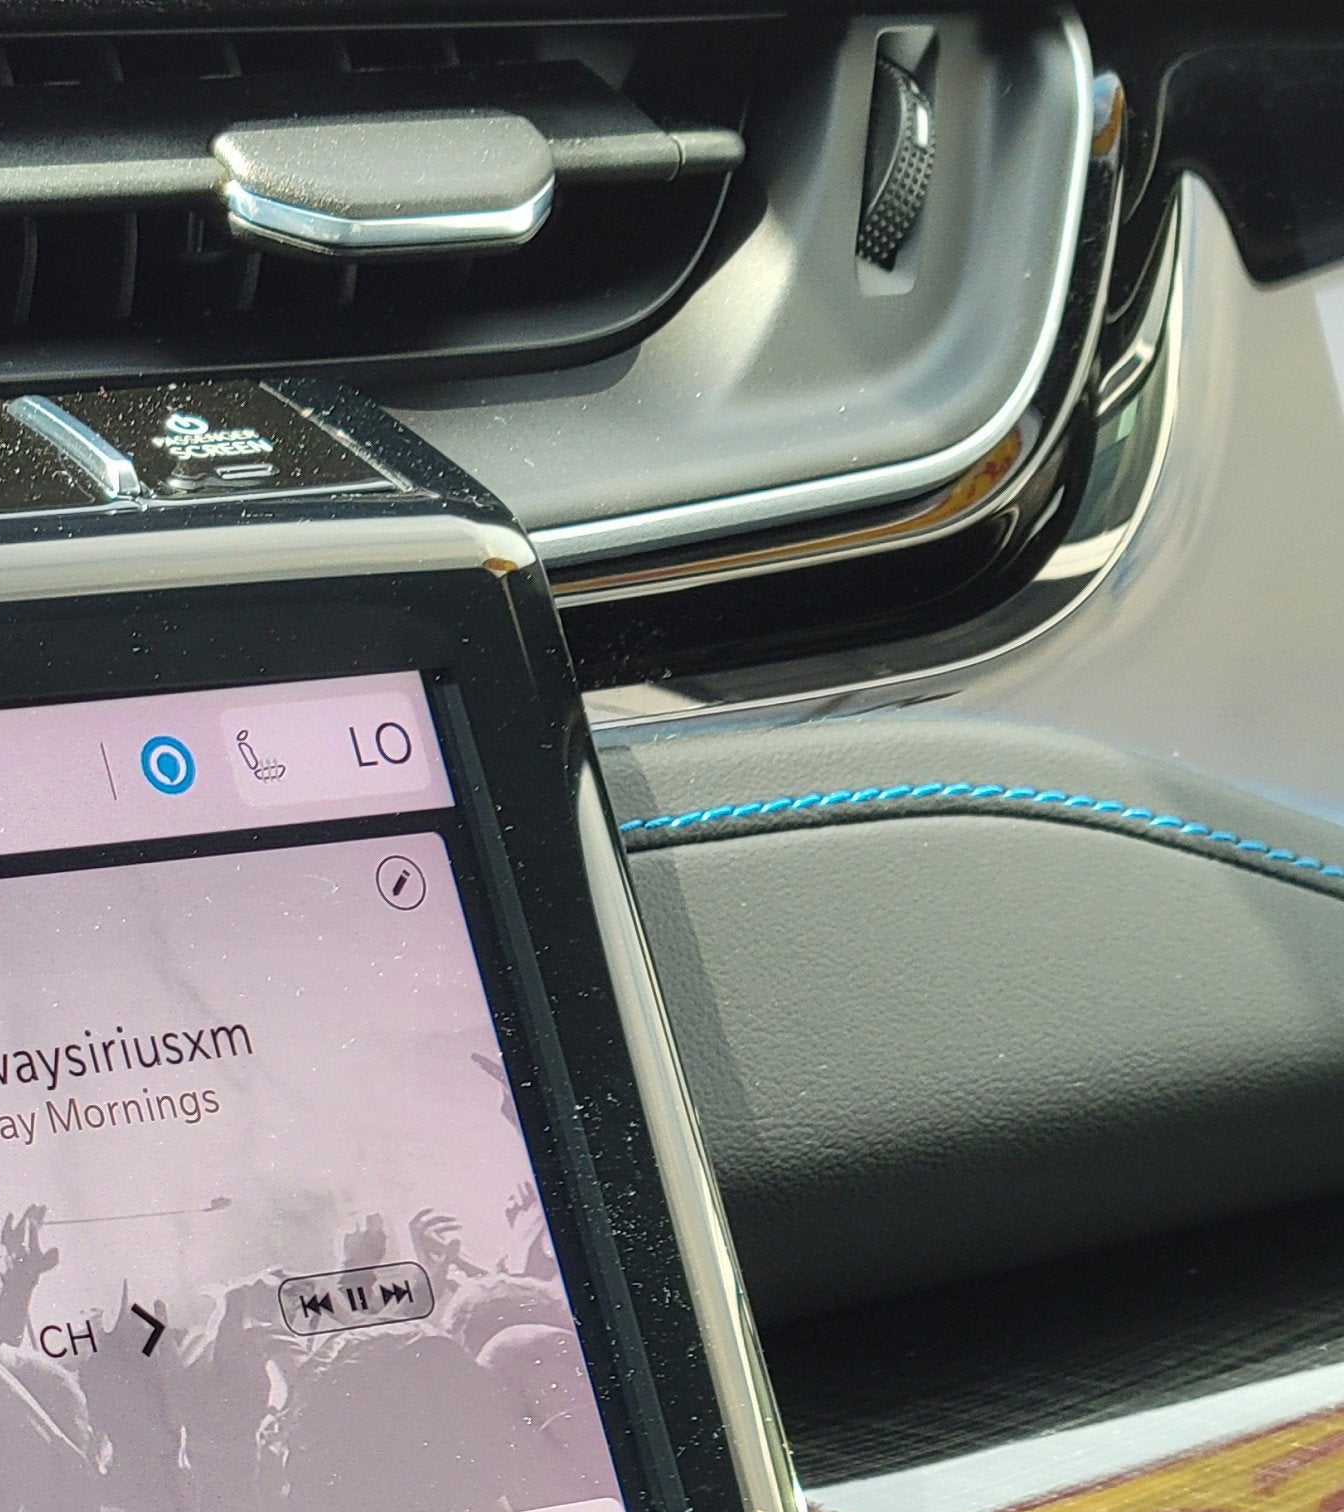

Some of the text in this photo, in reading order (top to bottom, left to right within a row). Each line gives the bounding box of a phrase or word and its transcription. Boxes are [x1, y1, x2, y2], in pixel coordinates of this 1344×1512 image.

[169, 437, 274, 460] SCREEN
[348, 721, 413, 769] LO
[45, 1086, 221, 1134] Mornings
[39, 1319, 99, 1360] CH
